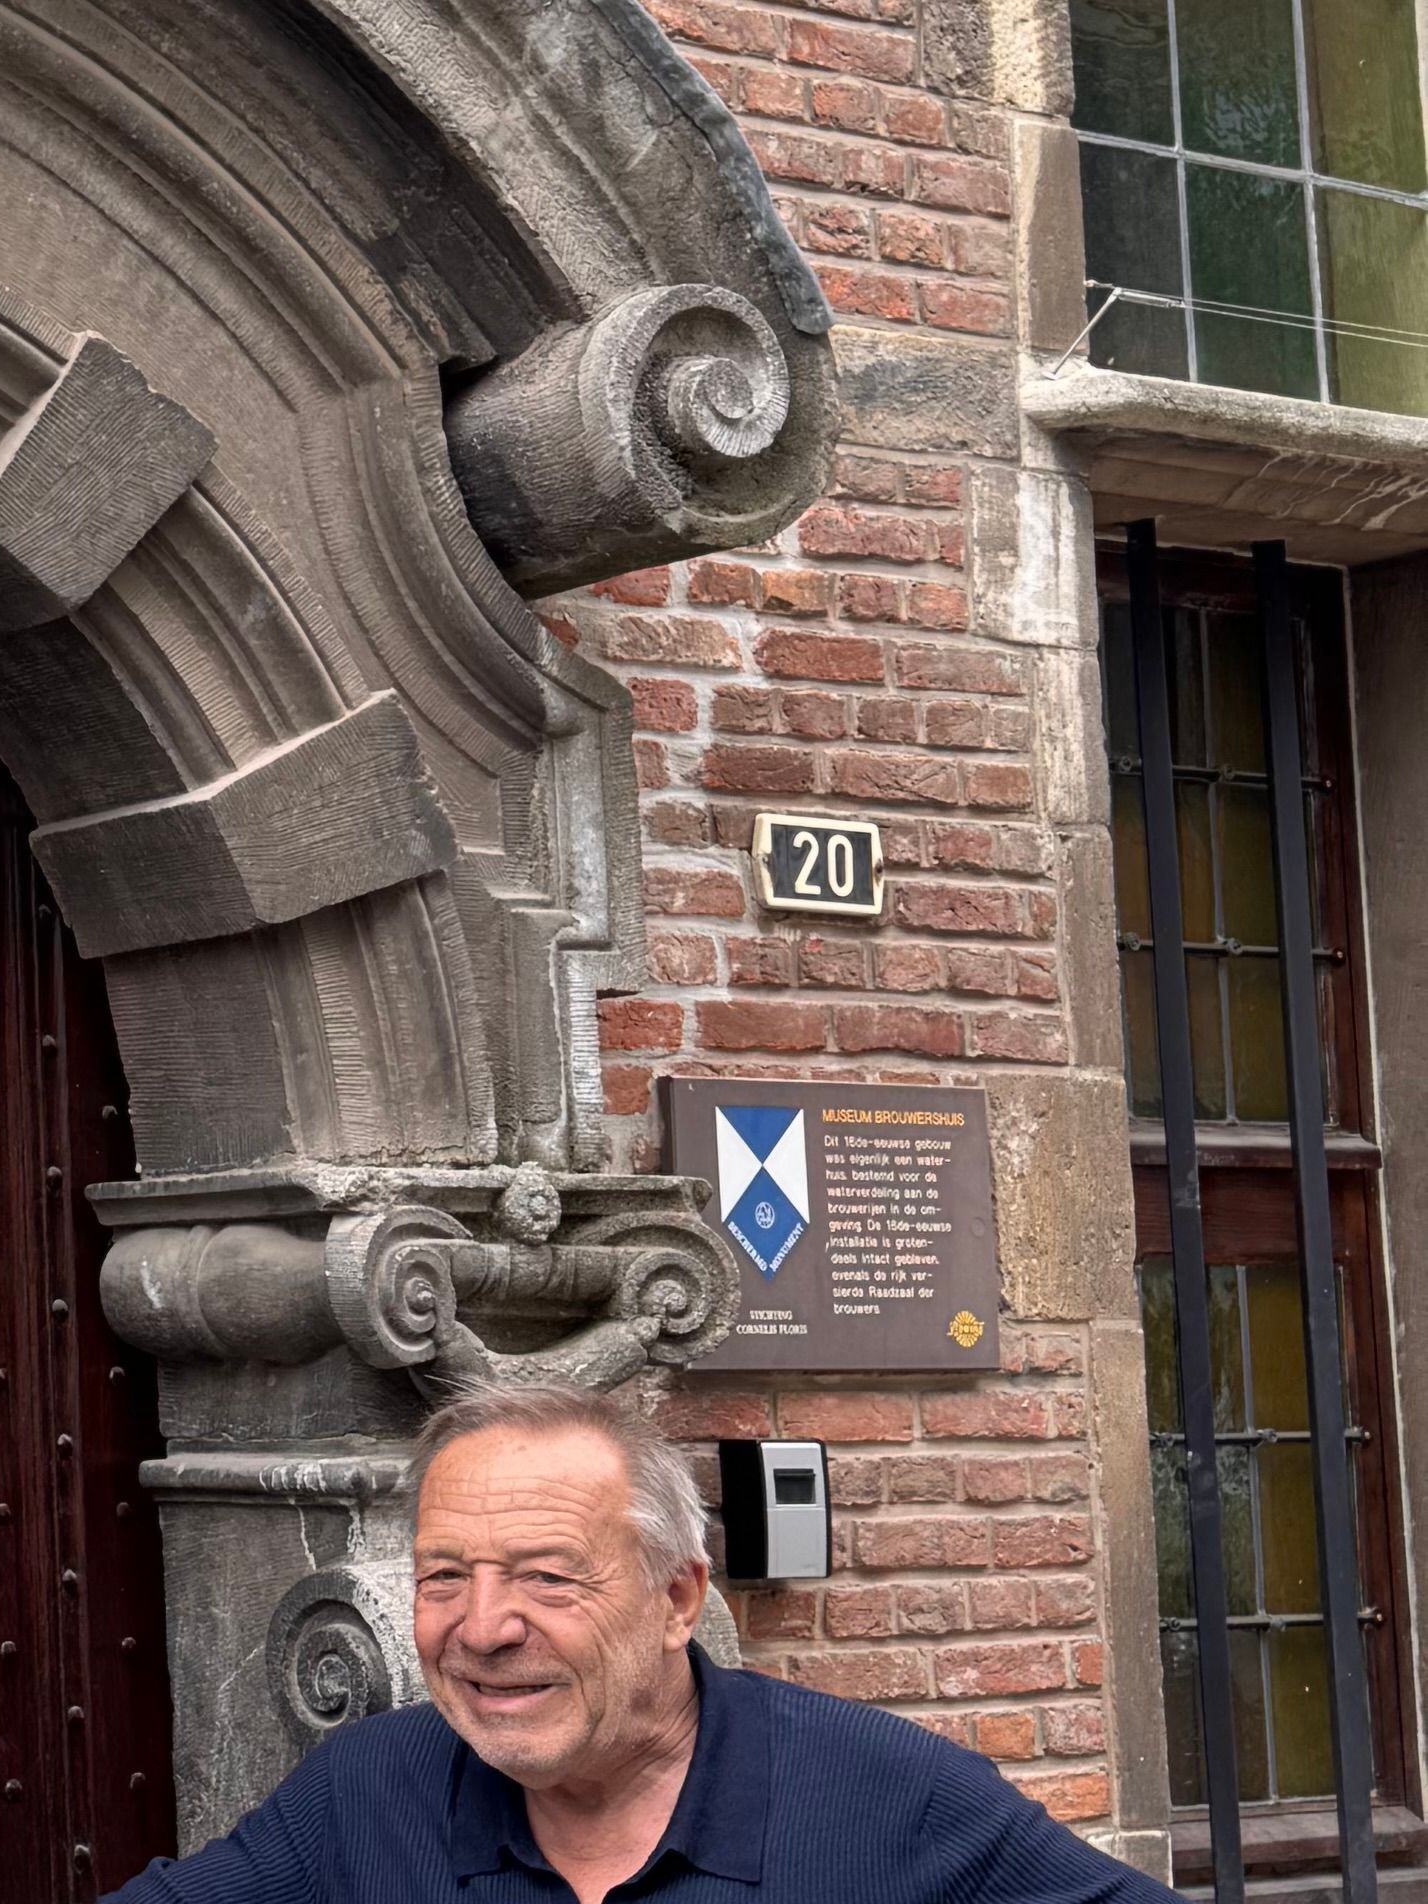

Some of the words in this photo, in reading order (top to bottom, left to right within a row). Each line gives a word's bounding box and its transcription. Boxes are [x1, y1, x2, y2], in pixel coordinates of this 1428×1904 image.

[793, 831, 854, 897] 20
[822, 1109, 872, 1124] MUSEUM
[874, 1110, 965, 1127] BROUWERSHUIS
[824, 1135, 839, 1147] Dit
[914, 1139, 952, 1152] gebouw
[825, 1154, 846, 1165] was
[849, 1153, 890, 1167] eigenlijk
[894, 1155, 913, 1166] een
[916, 1155, 952, 1167] water-
[851, 1169, 895, 1183] bestemd
[898, 1172, 921, 1183] voor
[924, 1172, 937, 1183] de
[826, 1186, 900, 1201] waterverdeling
[903, 1188, 923, 1200] aan
[926, 1188, 939, 1200] de
[827, 1203, 887, 1217] brouwerijen
[890, 1203, 900, 1215] in
[903, 1203, 917, 1216] de
[866, 1219, 882, 1232] De
[727, 1220, 769, 1272] BESCHERMD
[768, 1222, 805, 1273] MONUMENT
[829, 1235, 878, 1248] installatie
[882, 1236, 892, 1249] is
[830, 1252, 858, 1265] deels
[861, 1253, 891, 1265] intact
[831, 1270, 870, 1282] evenals
[873, 1270, 887, 1282] de
[891, 1270, 907, 1283] rijk
[832, 1286, 864, 1299] sierde
[868, 1285, 915, 1299] Raadzaal
[918, 1287, 935, 1299] der
[735, 1324, 778, 1335] CORNELIS
[778, 1324, 808, 1335] FLORIS
